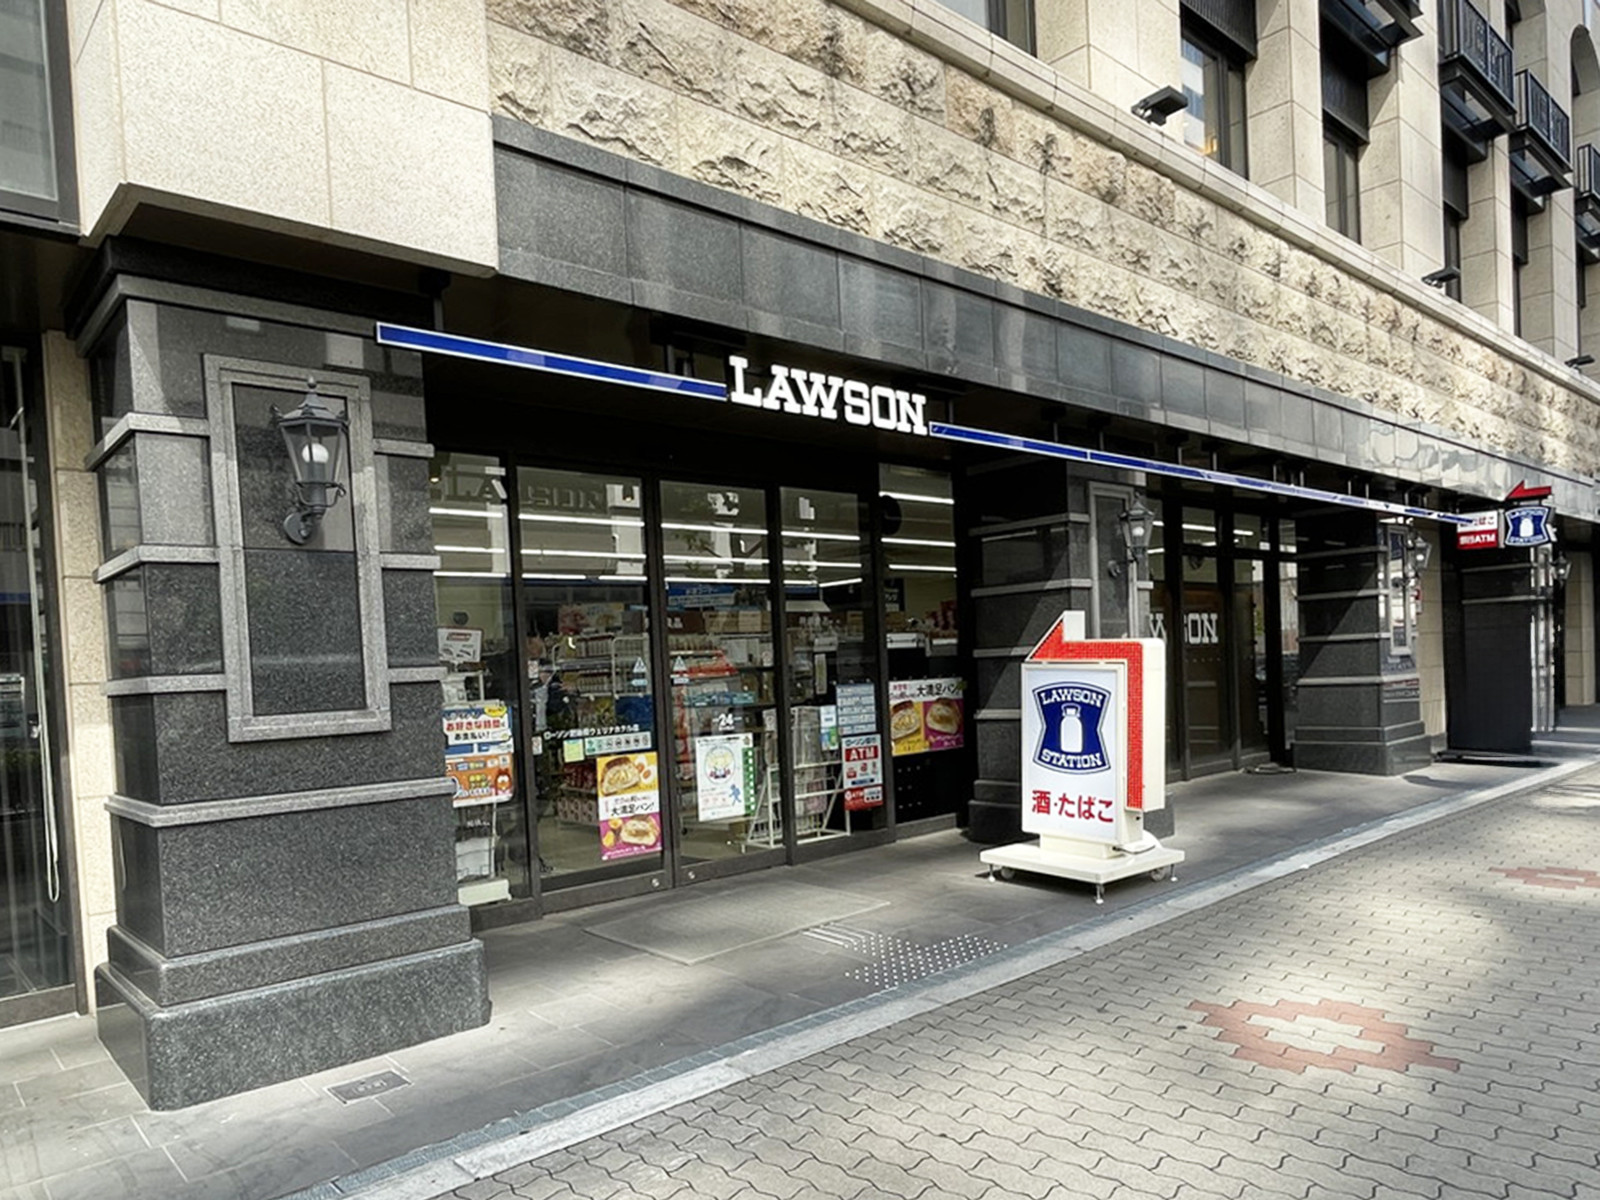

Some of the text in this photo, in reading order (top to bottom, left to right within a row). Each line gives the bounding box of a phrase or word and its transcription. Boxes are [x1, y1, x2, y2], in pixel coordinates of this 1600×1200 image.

[728, 354, 928, 436] LAWSON
[1040, 688, 1104, 708] LAWSON
[849, 746, 875, 761] ATM
[1041, 748, 1103, 769] STATION
[1032, 789, 1114, 823] 酒・たばこ
